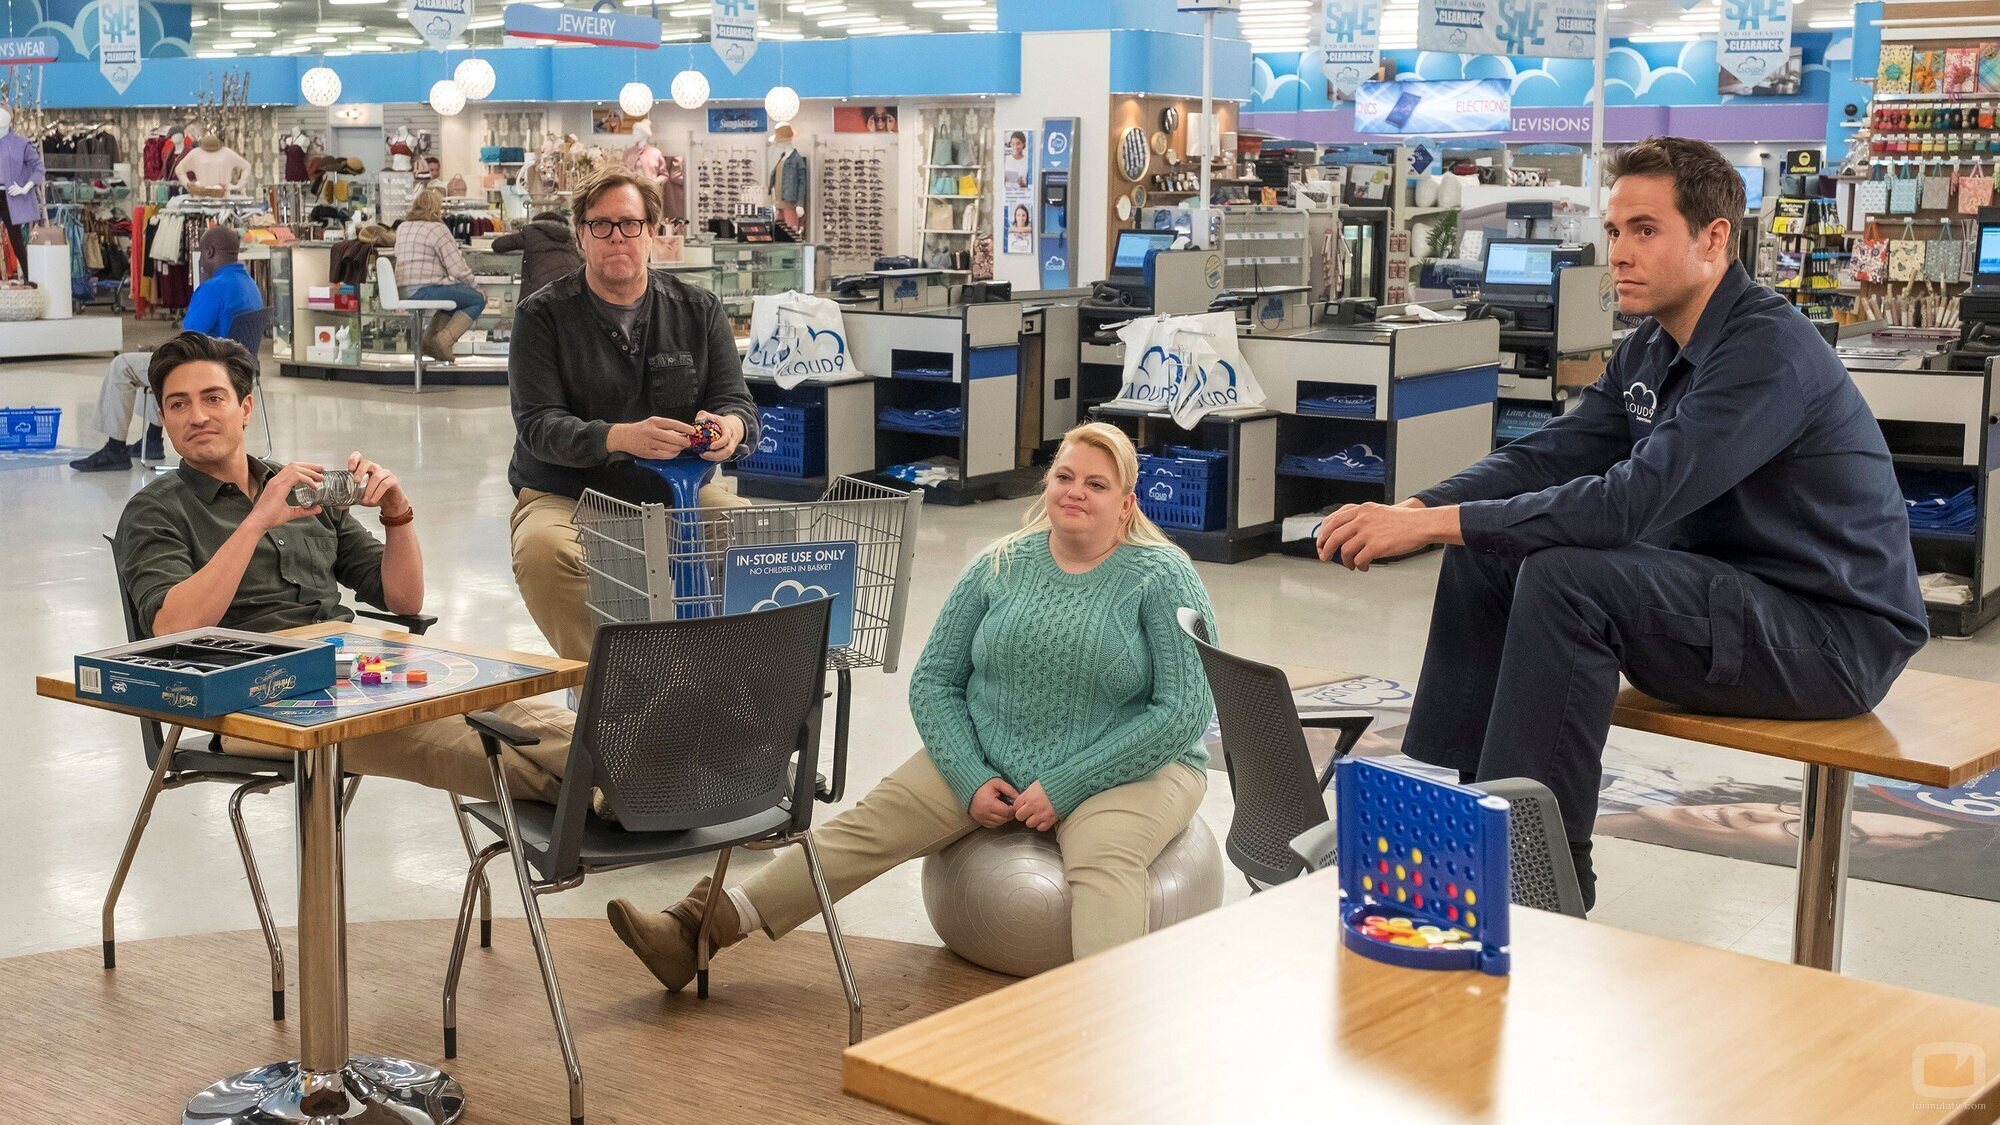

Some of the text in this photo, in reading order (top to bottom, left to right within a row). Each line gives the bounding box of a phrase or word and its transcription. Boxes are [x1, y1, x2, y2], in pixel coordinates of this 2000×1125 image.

[102, 3, 136, 43] SALE
[557, 14, 616, 37] JEWELRY
[1326, 2, 1377, 43] SALE
[1439, 11, 1480, 26] CLEARANCE
[1558, 19, 1593, 32] CLEARANCE
[719, 26, 752, 39] CLEARANCE
[1496, 0, 1548, 54] SALE
[17, 41, 45, 57] WEAR
[1729, 40, 1780, 51] CLEARANCE
[1329, 52, 1371, 62] CLEARANCE
[719, 118, 759, 130] Sunglasses
[1512, 116, 1590, 132] LEVISIONS
[1790, 165, 1817, 173] dummies
[1506, 408, 1526, 417] Lane
[736, 549, 846, 567] IN-STORE USE ONLY
[749, 567, 763, 575] NO
[763, 564, 796, 575] CHILDREN
[807, 563, 832, 572] BASKET
